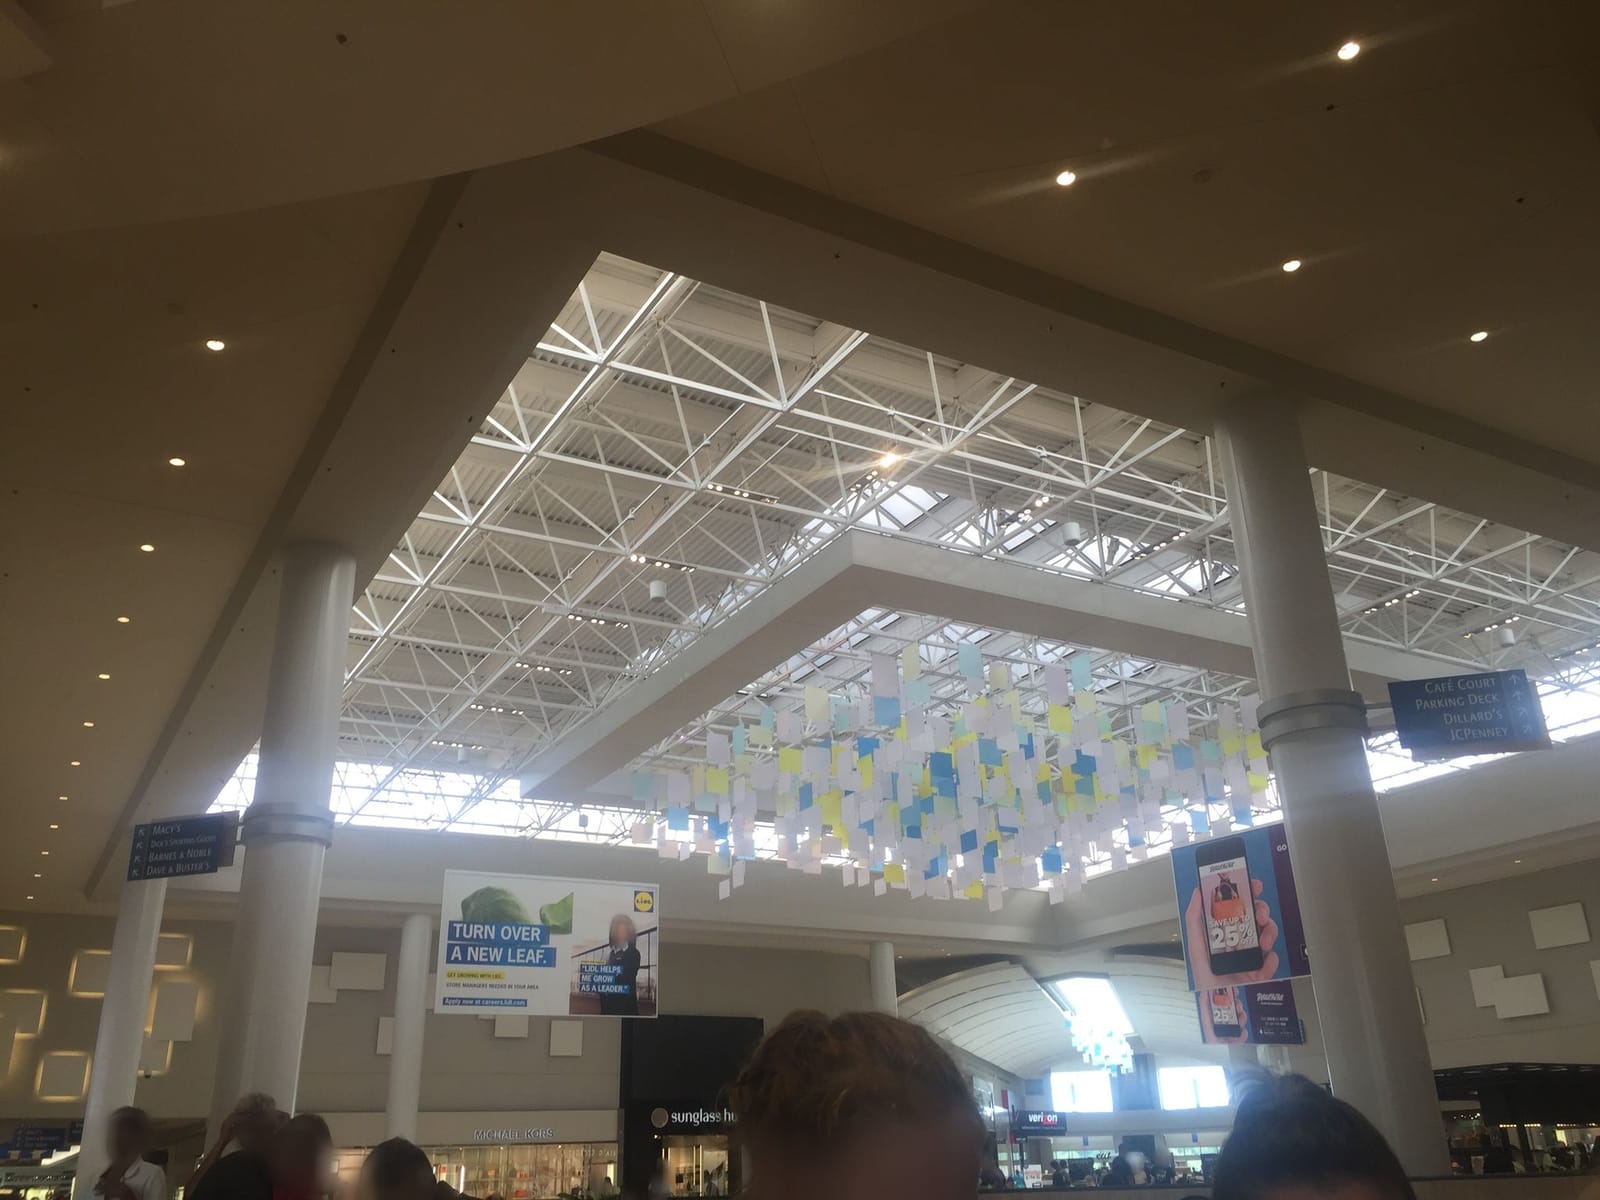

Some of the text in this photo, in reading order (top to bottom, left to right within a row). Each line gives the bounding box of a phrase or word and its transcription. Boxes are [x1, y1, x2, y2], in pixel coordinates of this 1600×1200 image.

[1457, 677, 1496, 690] COURT
[1415, 693, 1500, 710] PARKING DECK
[1443, 708, 1503, 725] DILLARD'S
[153, 823, 182, 834] MACY'S
[148, 850, 176, 862] BARNES
[186, 847, 212, 858] NOBLE
[453, 923, 540, 942] TURN OVER
[450, 945, 547, 964] A NEW LEAF.
[600, 965, 621, 974] HELPS
[581, 974, 614, 982] ME GROW
[581, 984, 591, 992] AS
[445, 997, 461, 1006] Apply
[671, 1108, 737, 1126] sunglass hu
[474, 1127, 554, 1140] MICHAEL KORS
